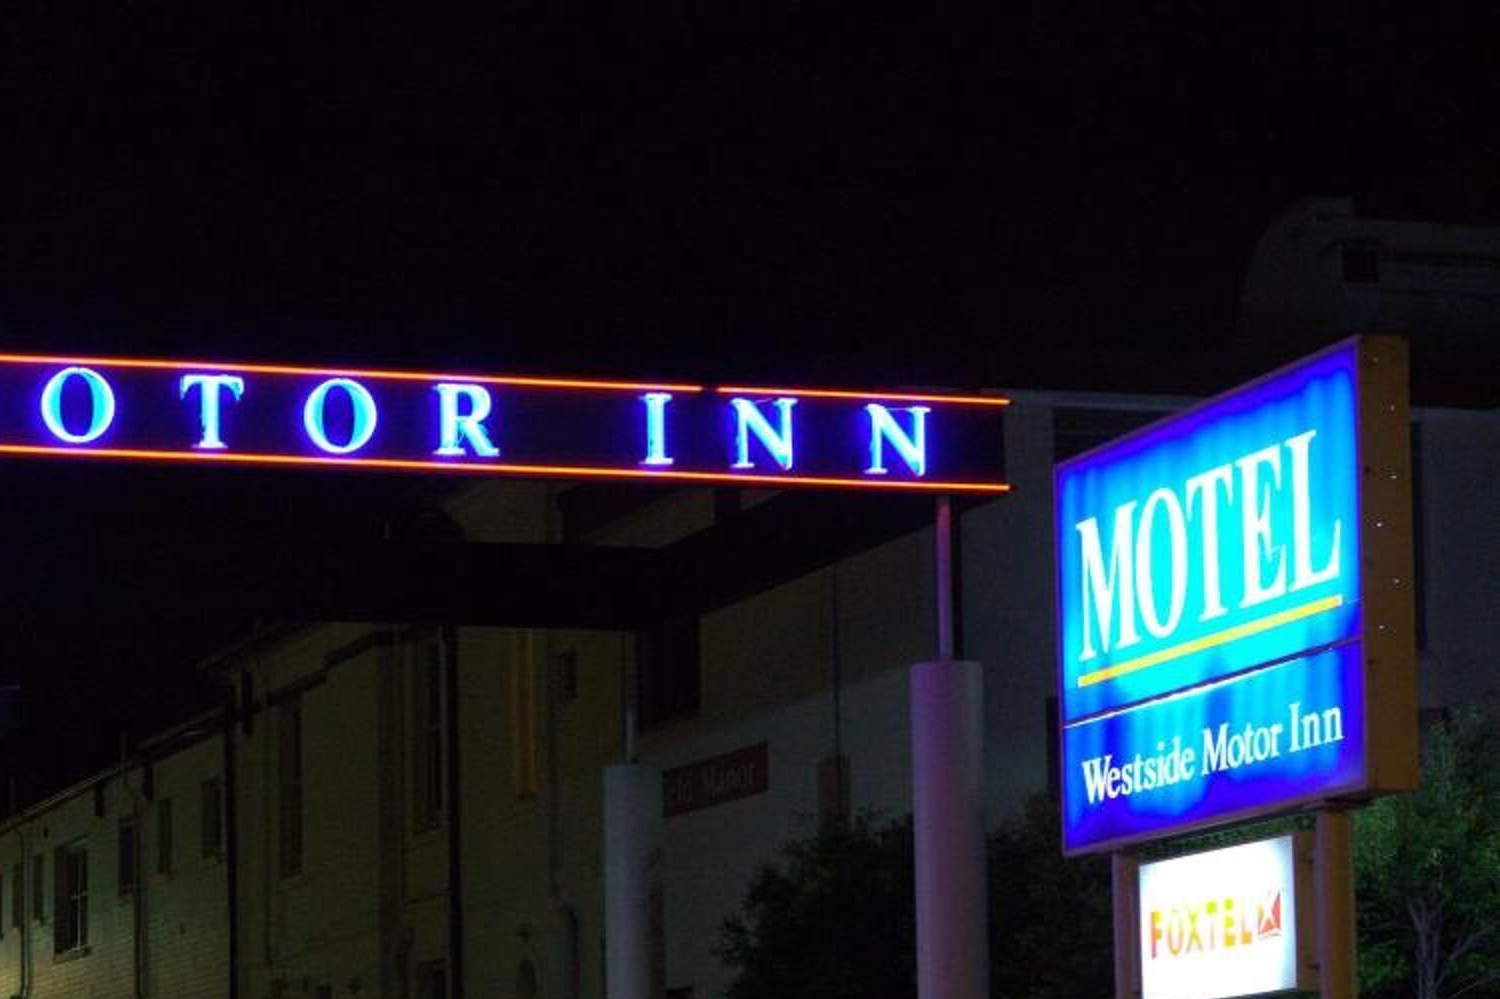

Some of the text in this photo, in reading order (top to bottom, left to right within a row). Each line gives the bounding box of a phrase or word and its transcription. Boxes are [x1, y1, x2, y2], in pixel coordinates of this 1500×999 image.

[639, 392, 931, 476] INN
[1076, 429, 1341, 661] MOTEL
[1081, 702, 1344, 805] Westside Motor Inn
[1149, 897, 1253, 960] FOXTEL
